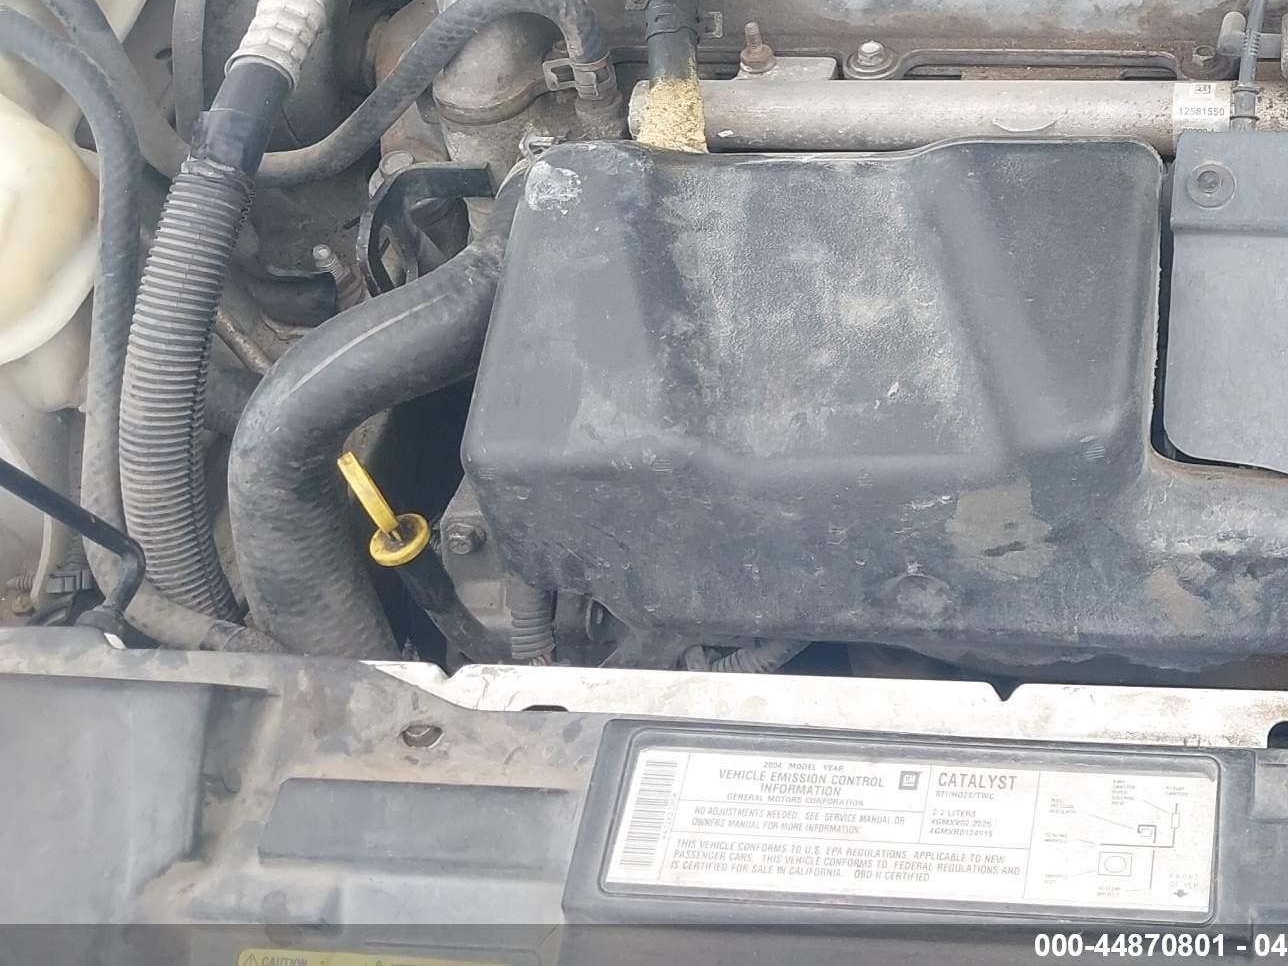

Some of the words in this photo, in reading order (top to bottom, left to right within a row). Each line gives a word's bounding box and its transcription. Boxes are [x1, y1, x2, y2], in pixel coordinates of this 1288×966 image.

[788, 762, 816, 771] MODEL
[719, 769, 767, 781] VEHICLE
[770, 771, 827, 785] EMISSION
[831, 774, 886, 787] CONTROL
[938, 772, 1018, 790] CATALYST
[760, 782, 842, 796] INFORMATION
[726, 793, 763, 802] GENERAL
[767, 795, 802, 804] MOTORS
[805, 797, 865, 807] CORPORATION
[691, 817, 726, 828] OWNERS
[727, 819, 760, 830] MANUAL
[762, 821, 779, 831] FOR
[780, 822, 803, 832] MORE
[694, 806, 706, 814] NO
[707, 806, 765, 817] ADJUSTMENTS
[804, 811, 820, 821] SEE
[824, 812, 857, 823] SERVICE
[858, 814, 890, 825] MANUAL
[894, 816, 905, 825] OR
[677, 838, 697, 849] THIS
[699, 840, 737, 851] VEHICLE
[738, 842, 787, 854] CONFORMS
[791, 845, 802, 854] TO
[826, 846, 843, 856] EPA
[846, 847, 908, 859] REGULATIONS
[913, 850, 966, 862] APPLICABLE
[970, 853, 982, 863] TO
[984, 854, 1005, 864] NEW
[670, 860, 681, 870] IS
[682, 861, 728, 873] CERTIFIED
[731, 863, 749, 873] FOR
[751, 864, 774, 875] SALE
[776, 865, 787, 875] IN
[854, 869, 873, 880] OBD
[673, 849, 726, 862] PASSENGER
[762, 854, 783, 864] THIS
[785, 855, 821, 866] VEHICLE
[823, 857, 874, 868] CONFORMS
[877, 859, 888, 869] TO
[893, 861, 932, 872] FEDERAL
[936, 863, 999, 875] REGULATIONS
[1001, 866, 1021, 876] AND
